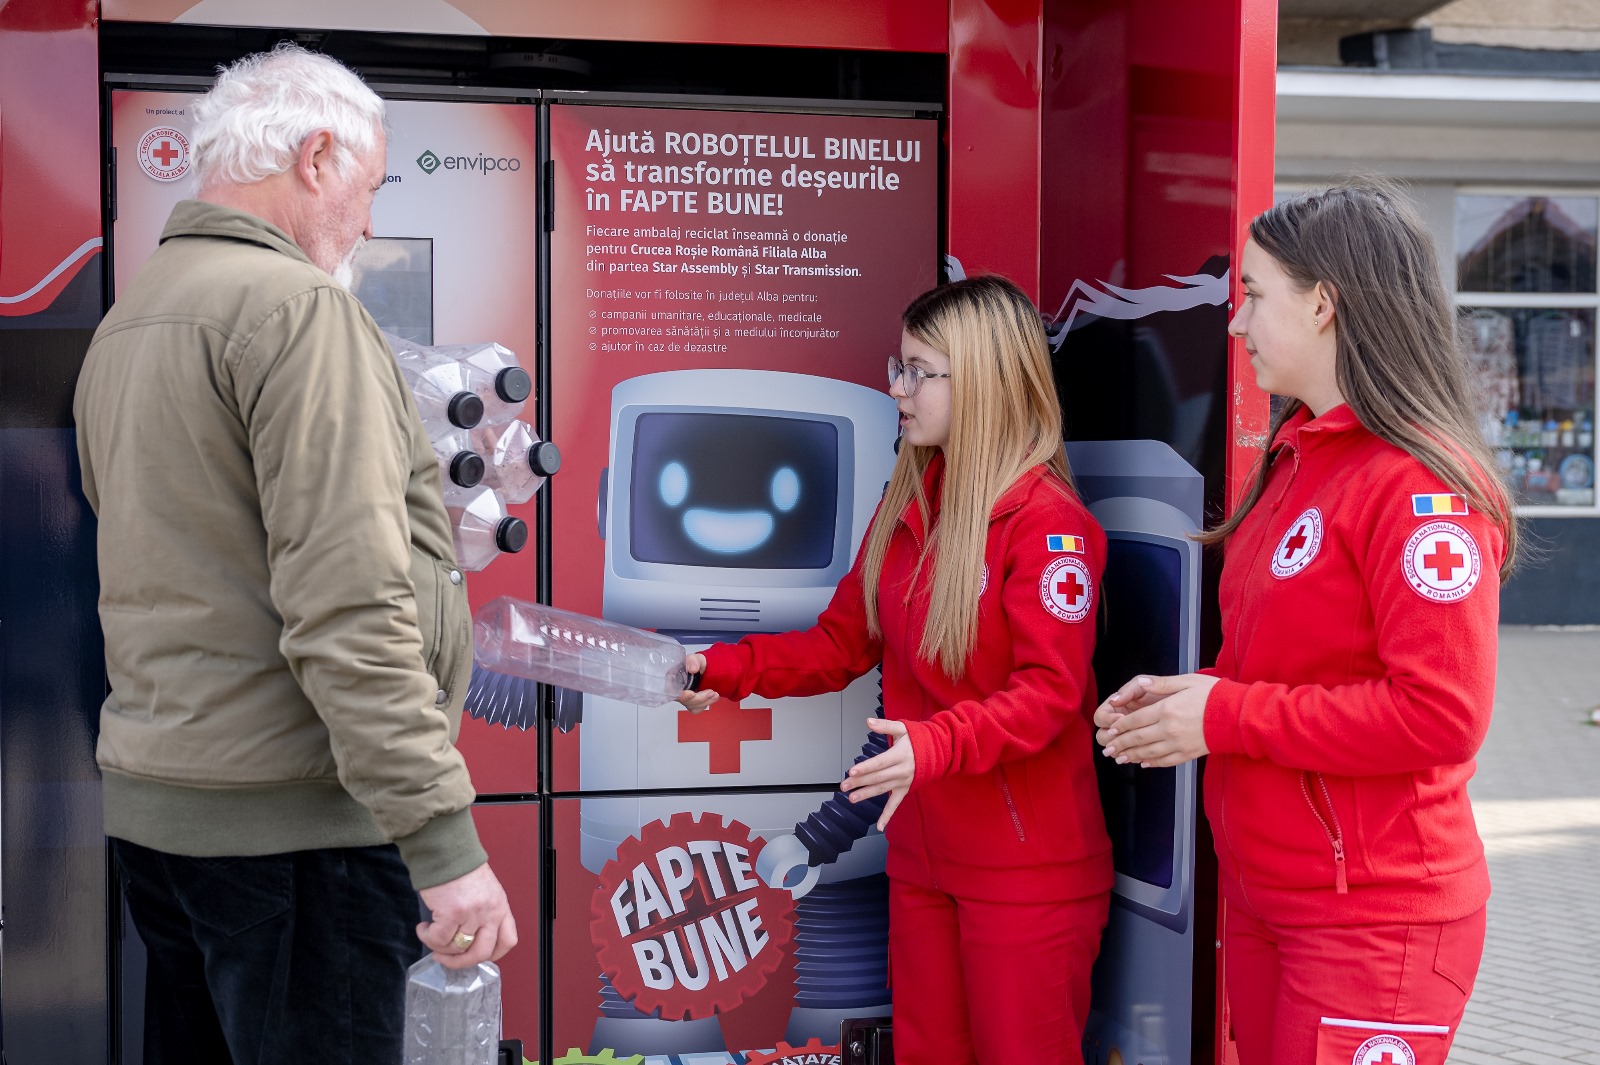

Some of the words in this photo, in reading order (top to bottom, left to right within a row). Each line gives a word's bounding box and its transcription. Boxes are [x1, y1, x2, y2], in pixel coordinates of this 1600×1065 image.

[142, 133, 156, 154] CRUCEA
[584, 129, 656, 158] Ajută
[665, 132, 816, 166] ROBOȚELUL
[824, 137, 920, 162] BINELUI
[148, 165, 170, 178] FILIALA
[172, 166, 185, 176] ALBA
[444, 152, 520, 176] envipco
[385, 174, 402, 183] on
[586, 158, 616, 182] să
[624, 160, 772, 186] transforme
[782, 164, 900, 197] deșeurile
[586, 188, 610, 211] în
[620, 190, 698, 214] FAPTE
[708, 192, 784, 216] BUNE!
[586, 225, 630, 237] Fiecare
[634, 226, 681, 240] ambalaj
[685, 228, 728, 240] reciclat
[732, 228, 788, 241] înseamnă
[792, 232, 800, 242] o
[804, 230, 848, 246] donație
[586, 244, 626, 256] pentru
[630, 244, 672, 256] Crucea
[676, 244, 708, 260] Roșie
[712, 245, 759, 258] Română
[762, 246, 798, 258] Filiala
[800, 248, 826, 259] Alba
[586, 260, 605, 272] din
[610, 262, 648, 274] partea
[652, 262, 678, 272] Star
[680, 262, 738, 276] Assembly
[742, 262, 751, 278] și
[755, 264, 780, 275] Star
[782, 264, 862, 276] Transmission.
[586, 288, 632, 300] Donațiile
[635, 291, 652, 299] vor
[654, 289, 662, 299] fi
[665, 290, 703, 300] folosite
[706, 290, 715, 300] în
[718, 290, 754, 304] județul
[757, 292, 778, 302] Alba
[782, 293, 818, 304] pentru:
[602, 310, 647, 322] campanii
[652, 310, 705, 322] umanitare,
[708, 311, 775, 324] educaționale,
[778, 312, 822, 322] medicale
[602, 327, 662, 337] promovarea
[666, 326, 710, 338] sănătății
[713, 326, 720, 339] și
[724, 329, 730, 337] a
[734, 326, 777, 338] mediului
[780, 326, 840, 340] înconjurător
[602, 340, 632, 352] ajutor
[634, 340, 644, 352] în
[648, 344, 664, 352] caz
[668, 342, 680, 352] de
[684, 342, 728, 352] dezastre
[1426, 588, 1466, 599] ROMANIA
[610, 840, 760, 938] FAPTE
[632, 897, 770, 990] BUNE
